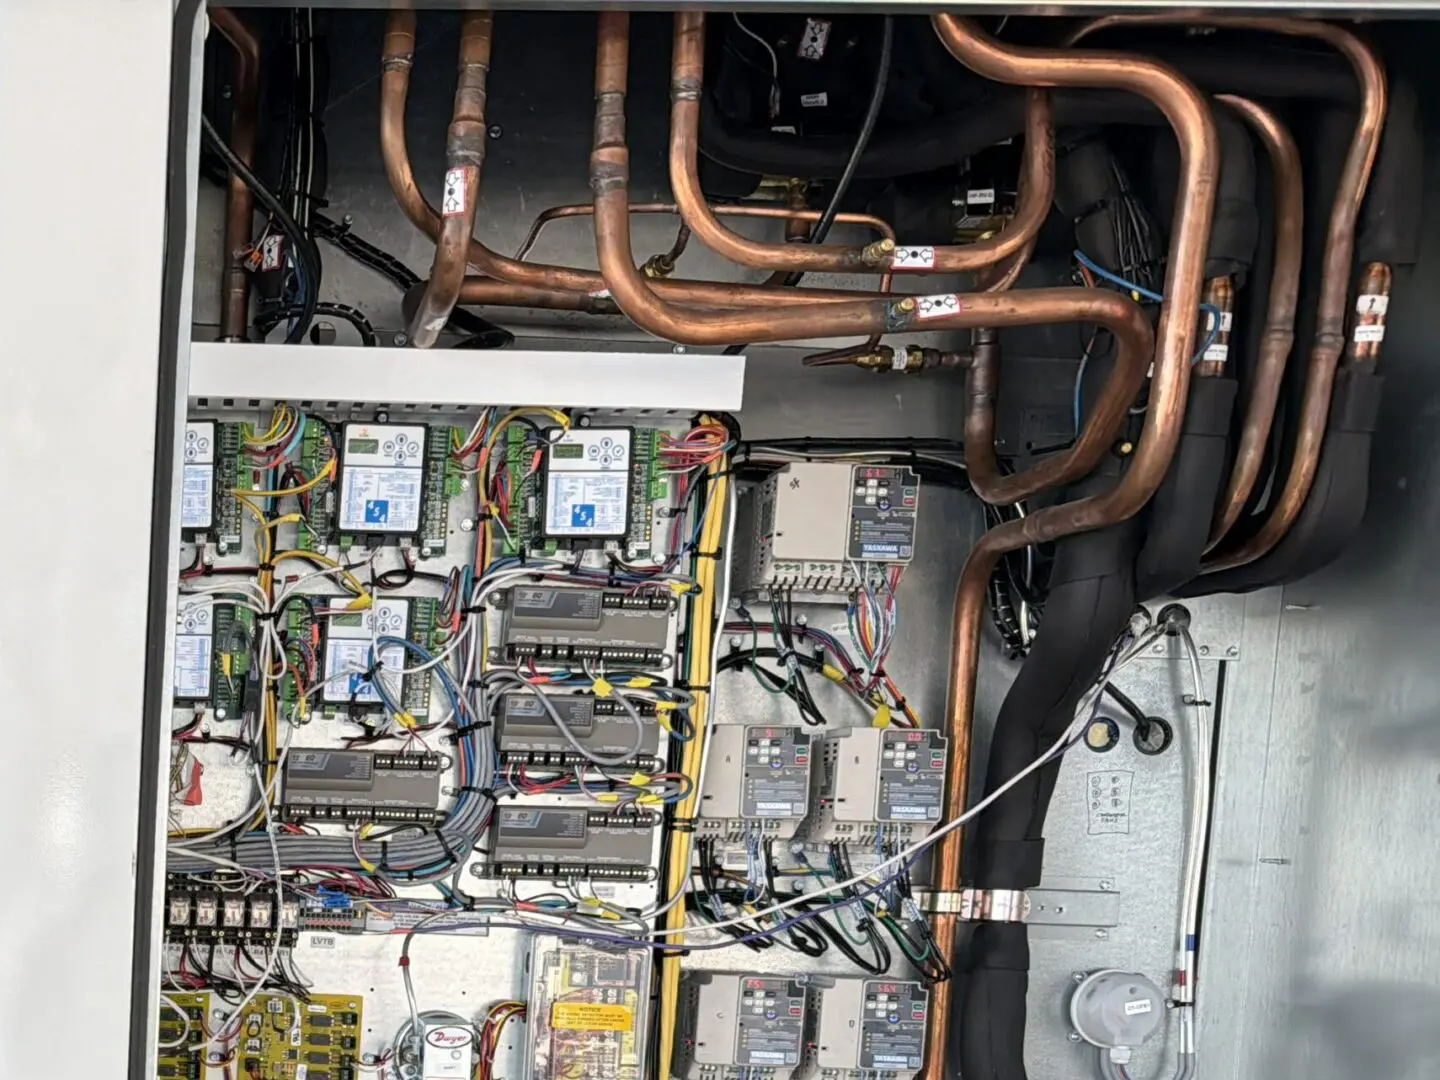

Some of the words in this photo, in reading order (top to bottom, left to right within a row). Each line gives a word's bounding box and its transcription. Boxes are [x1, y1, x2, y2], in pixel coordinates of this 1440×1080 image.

[863, 544, 898, 552] YASKAWA
[312, 937, 334, 946] LVTB
[434, 1032, 467, 1044] Dwyer
